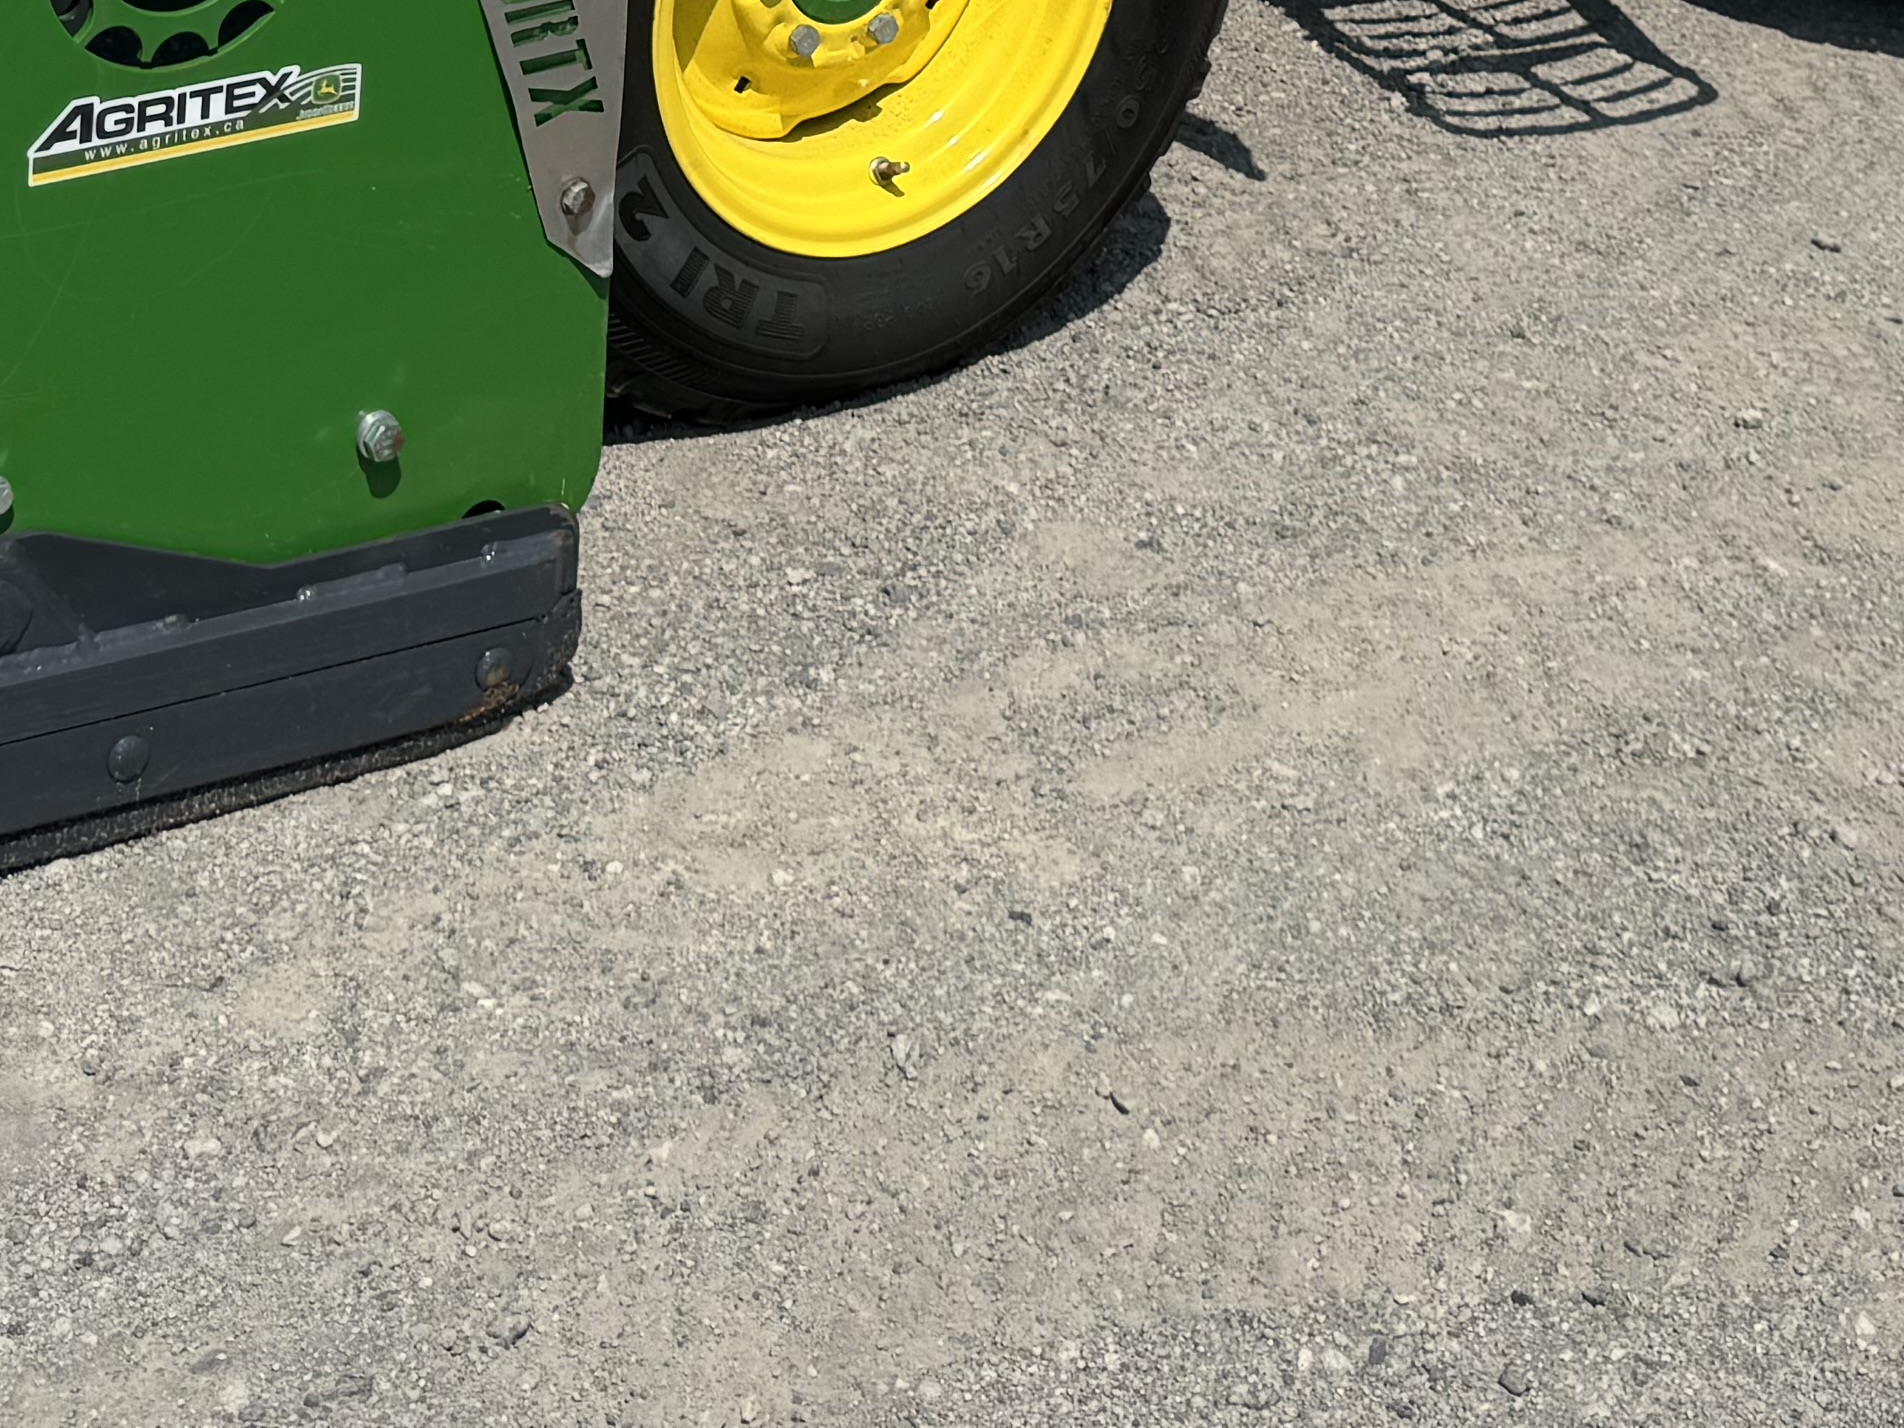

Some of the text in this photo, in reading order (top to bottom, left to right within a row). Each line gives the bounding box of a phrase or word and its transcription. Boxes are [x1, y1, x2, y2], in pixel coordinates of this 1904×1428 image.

[34, 70, 294, 154] AGRITEX
[84, 118, 246, 163] www.agritex.ca
[617, 174, 672, 243] 2
[668, 245, 807, 343] TRI
